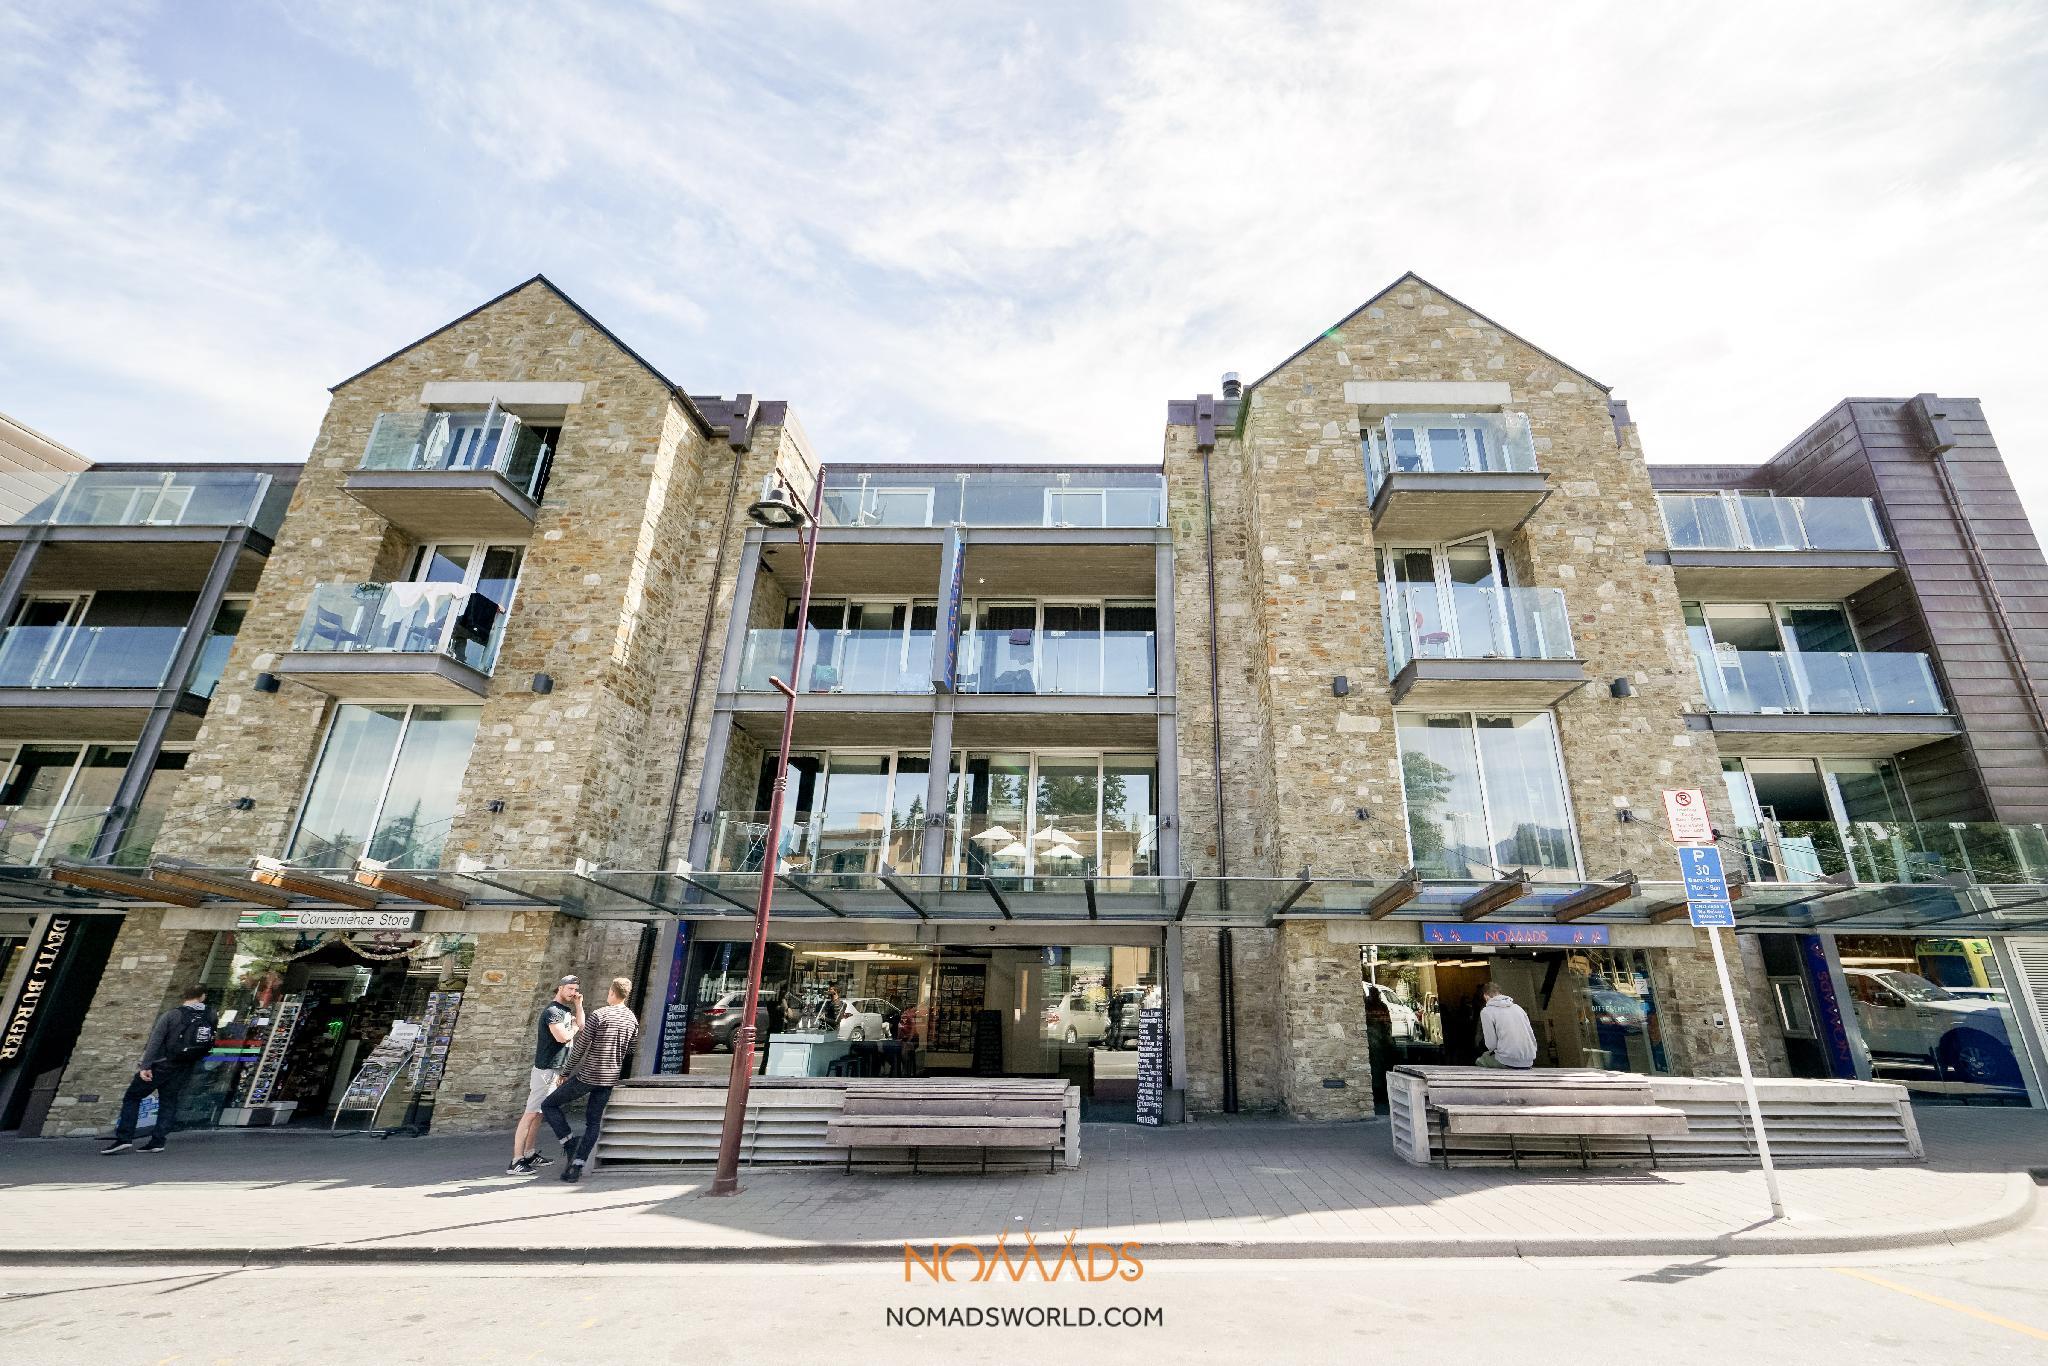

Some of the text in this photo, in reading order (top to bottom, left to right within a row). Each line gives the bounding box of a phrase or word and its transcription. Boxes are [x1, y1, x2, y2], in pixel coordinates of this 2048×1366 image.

[1692, 849, 1705, 863] P
[1694, 864, 1710, 876] 30
[300, 913, 410, 926] Convenience Store
[1485, 928, 1549, 943] NOMADS
[0, 918, 71, 1061] DEVIL BURGER
[1817, 970, 1850, 1062] NOMADS
